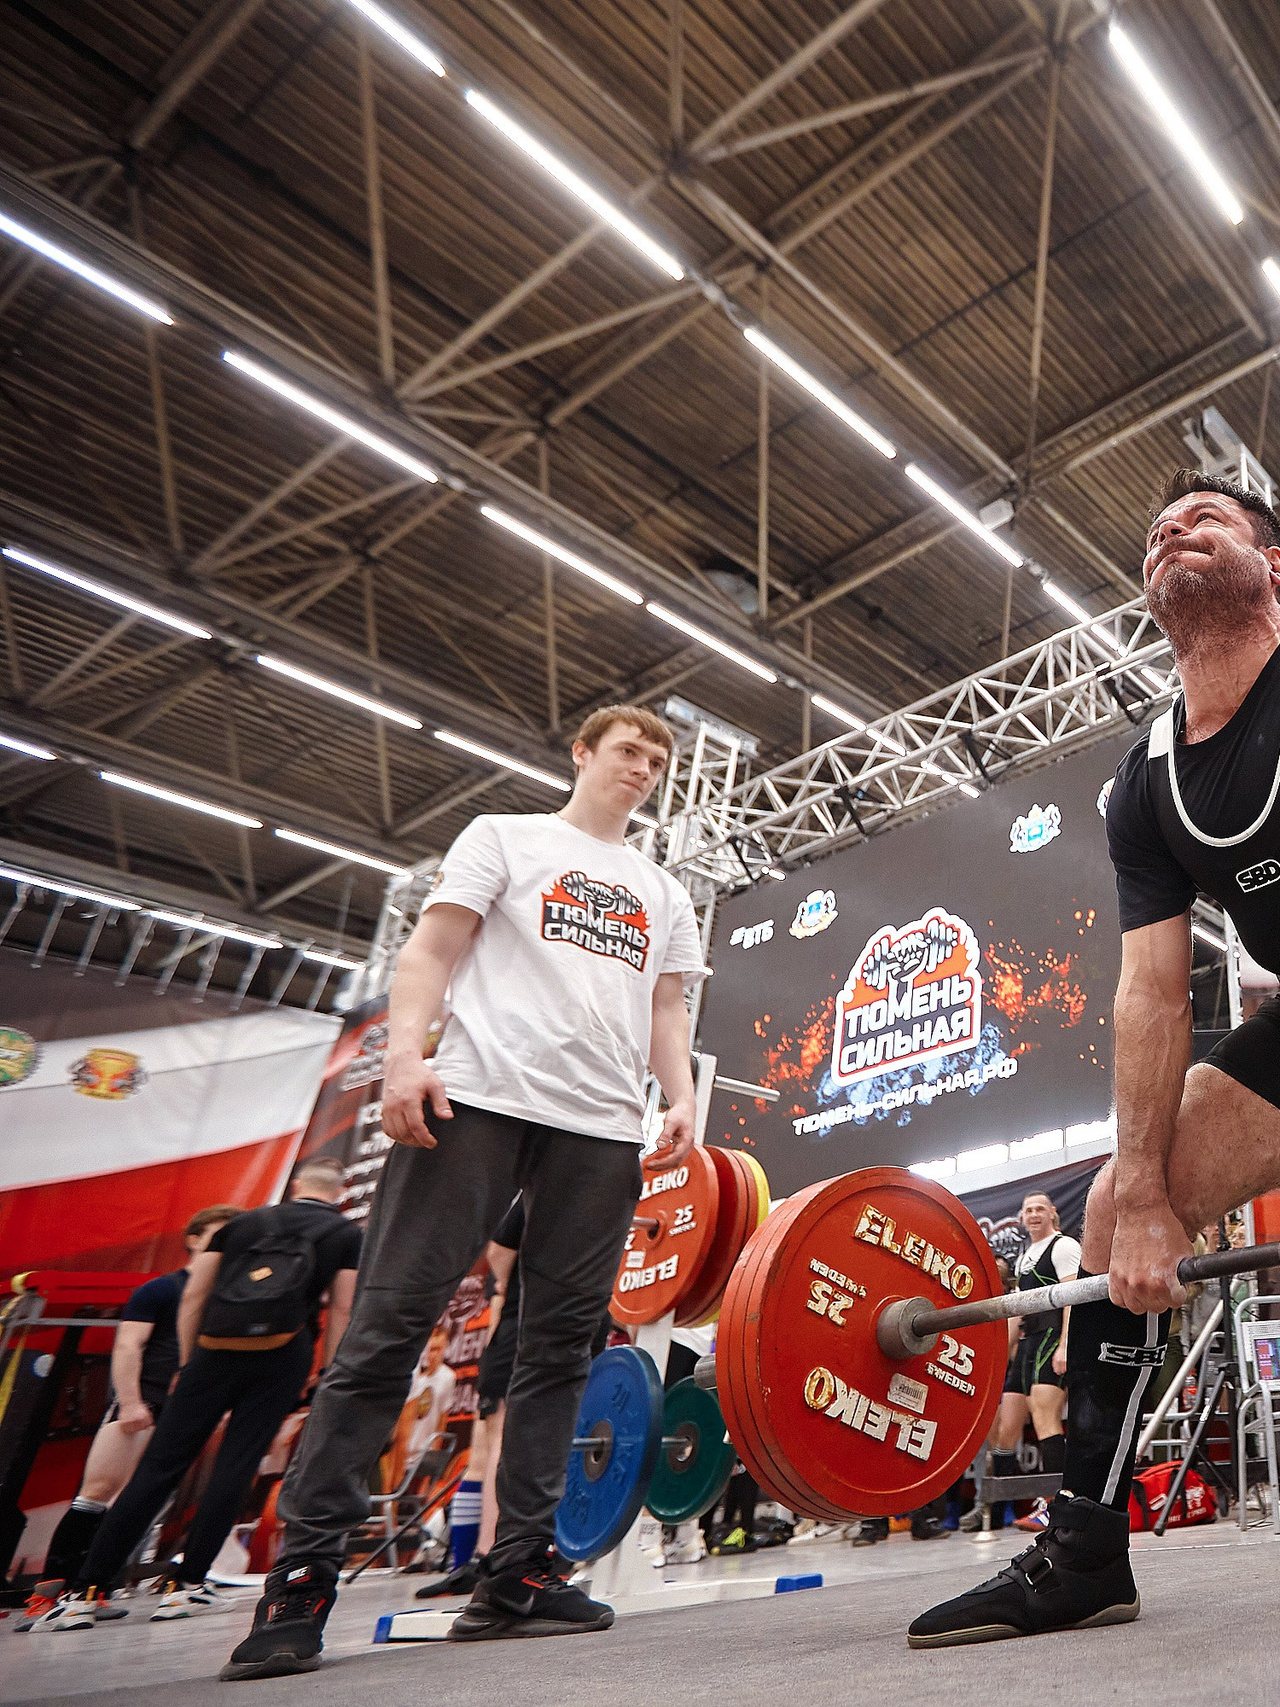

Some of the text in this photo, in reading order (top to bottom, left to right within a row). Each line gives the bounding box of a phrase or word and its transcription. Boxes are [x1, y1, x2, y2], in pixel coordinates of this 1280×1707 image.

[544, 922, 644, 969] СИЛЬНАЯ
[546, 900, 648, 949] ТЮМЕНЬ
[845, 975, 973, 1039] ТЮМЕНЬ
[840, 1007, 971, 1074] СИЛЬНАЯ
[792, 1057, 1018, 1136] ТЮМЕНЬ-СИЛЬНАЯ.РФ
[639, 1166, 689, 1201] LEIKO
[673, 1204, 694, 1226] 25
[619, 1254, 679, 1293] ELEIKO
[853, 1203, 975, 1300] ELEIKO
[806, 1279, 855, 1327] 25
[925, 1361, 976, 1397] SWEDEN
[937, 1334, 975, 1377] 25
[804, 1366, 938, 1462] ELEIKO
